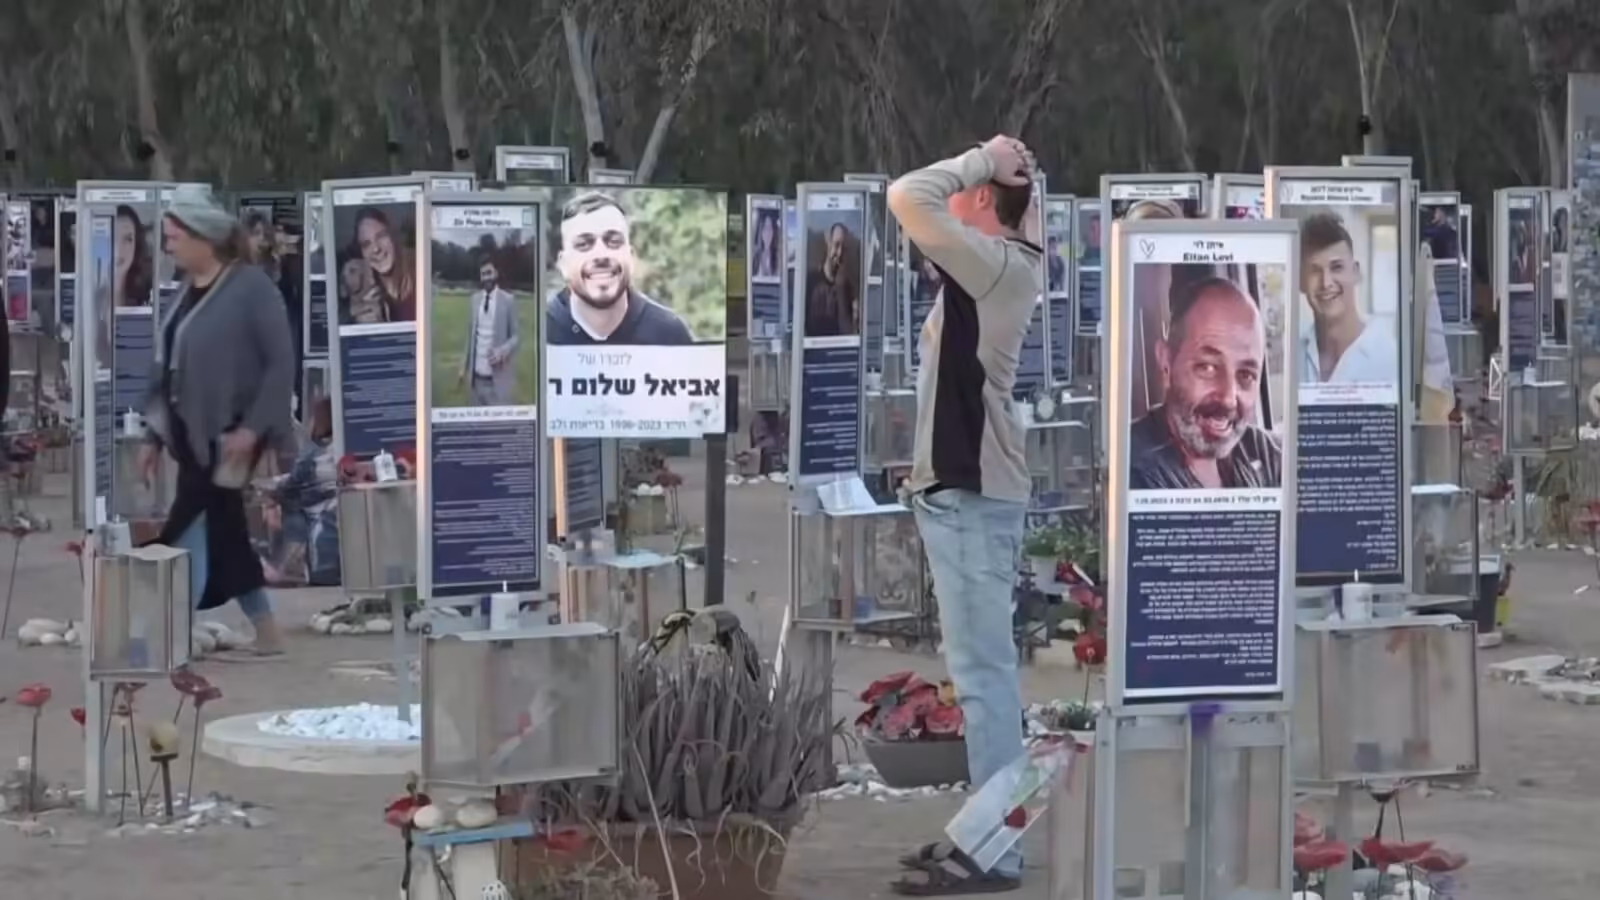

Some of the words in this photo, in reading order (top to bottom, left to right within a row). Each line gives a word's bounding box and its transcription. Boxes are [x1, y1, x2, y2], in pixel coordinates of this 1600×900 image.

[1183, 252, 1210, 261] Eitan
[1212, 252, 1233, 261] Levi
[577, 352, 596, 366] של
[601, 352, 632, 366] לזכרו
[572, 373, 636, 396] שלום
[644, 373, 720, 396] אביאל
